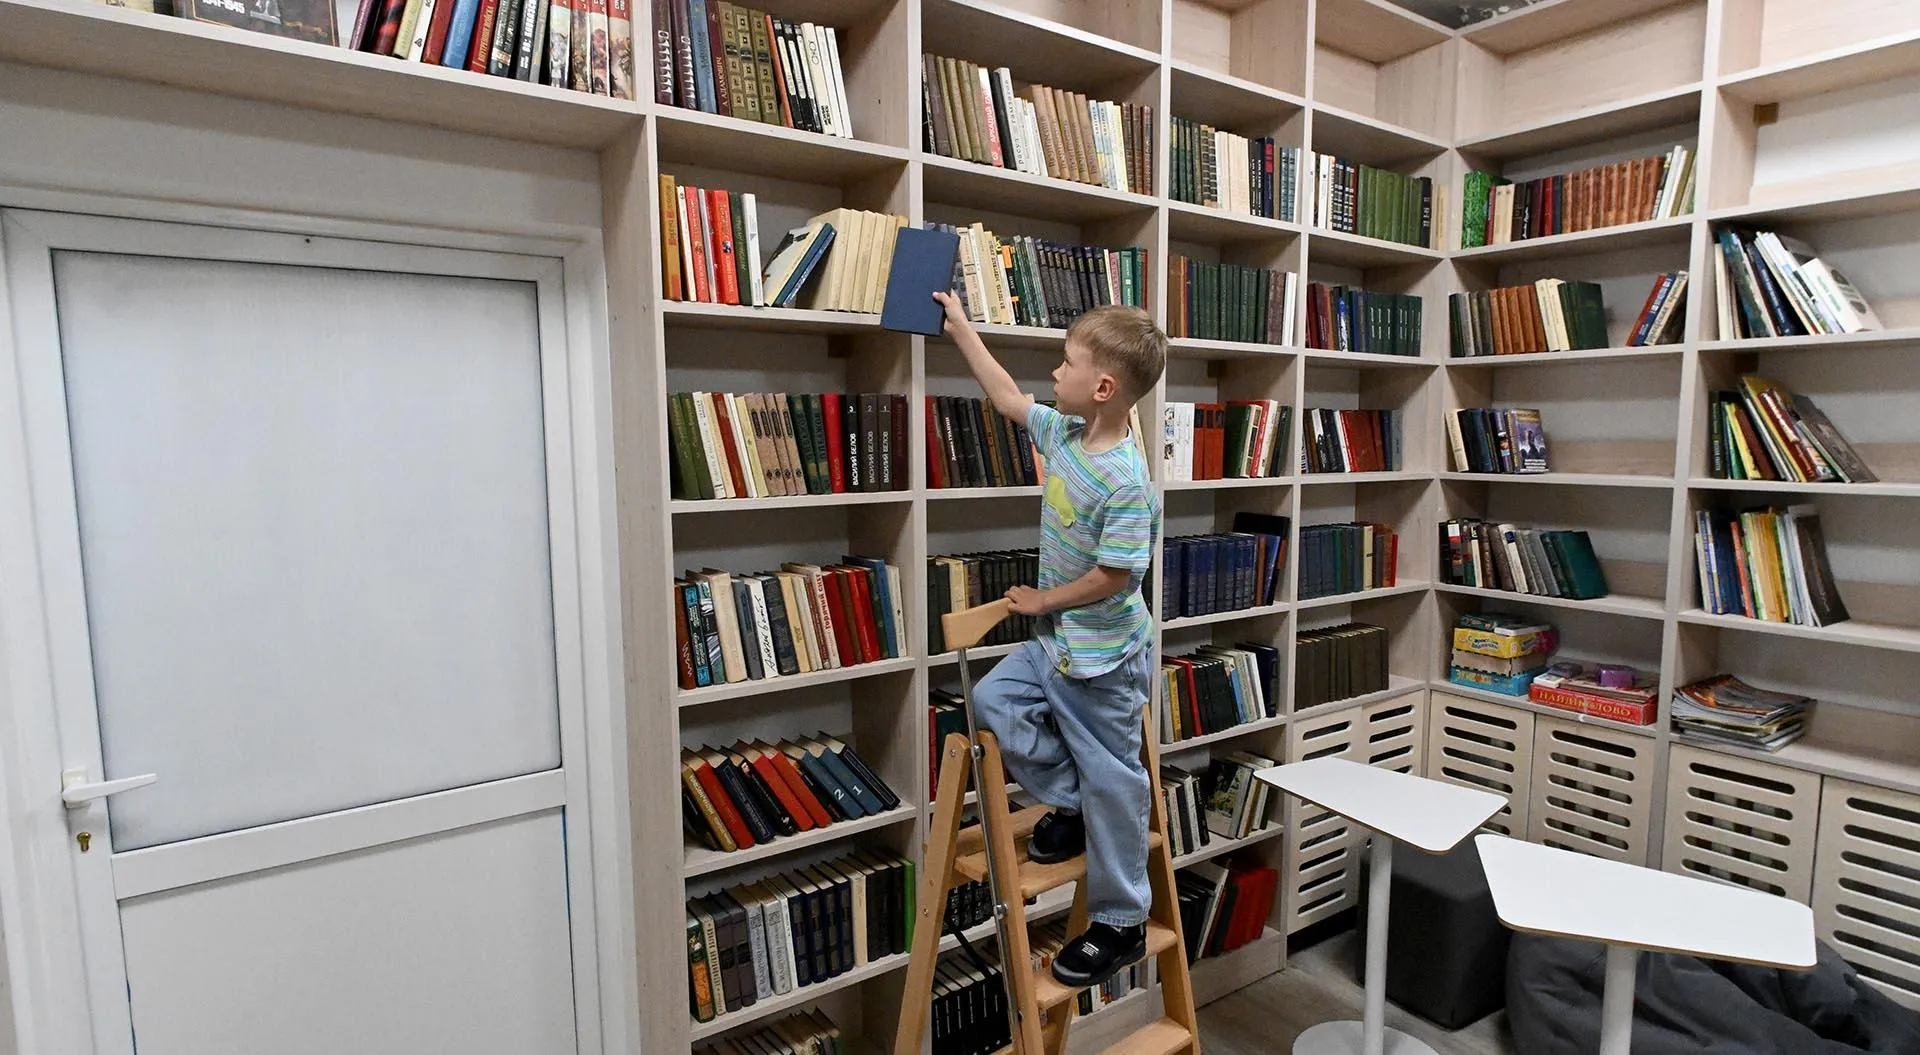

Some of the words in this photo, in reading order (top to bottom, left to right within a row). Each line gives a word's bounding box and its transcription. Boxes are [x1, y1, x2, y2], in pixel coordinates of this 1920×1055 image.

[202, 0, 245, 14] 41-1945
[716, 57, 728, 98] АДАМОВИЧ
[985, 106, 997, 142] АРКАДИЙ
[849, 433, 857, 455] БЕЛОВ
[850, 455, 859, 486] ВАСИЛИЙ
[867, 454, 876, 484] ВАСИЛИЙ
[882, 454, 890, 484] ВАСИЛИЙ
[820, 593, 832, 630] ГОРЯЧИЙ
[833, 788, 845, 801] 2
[852, 784, 862, 796] 1
